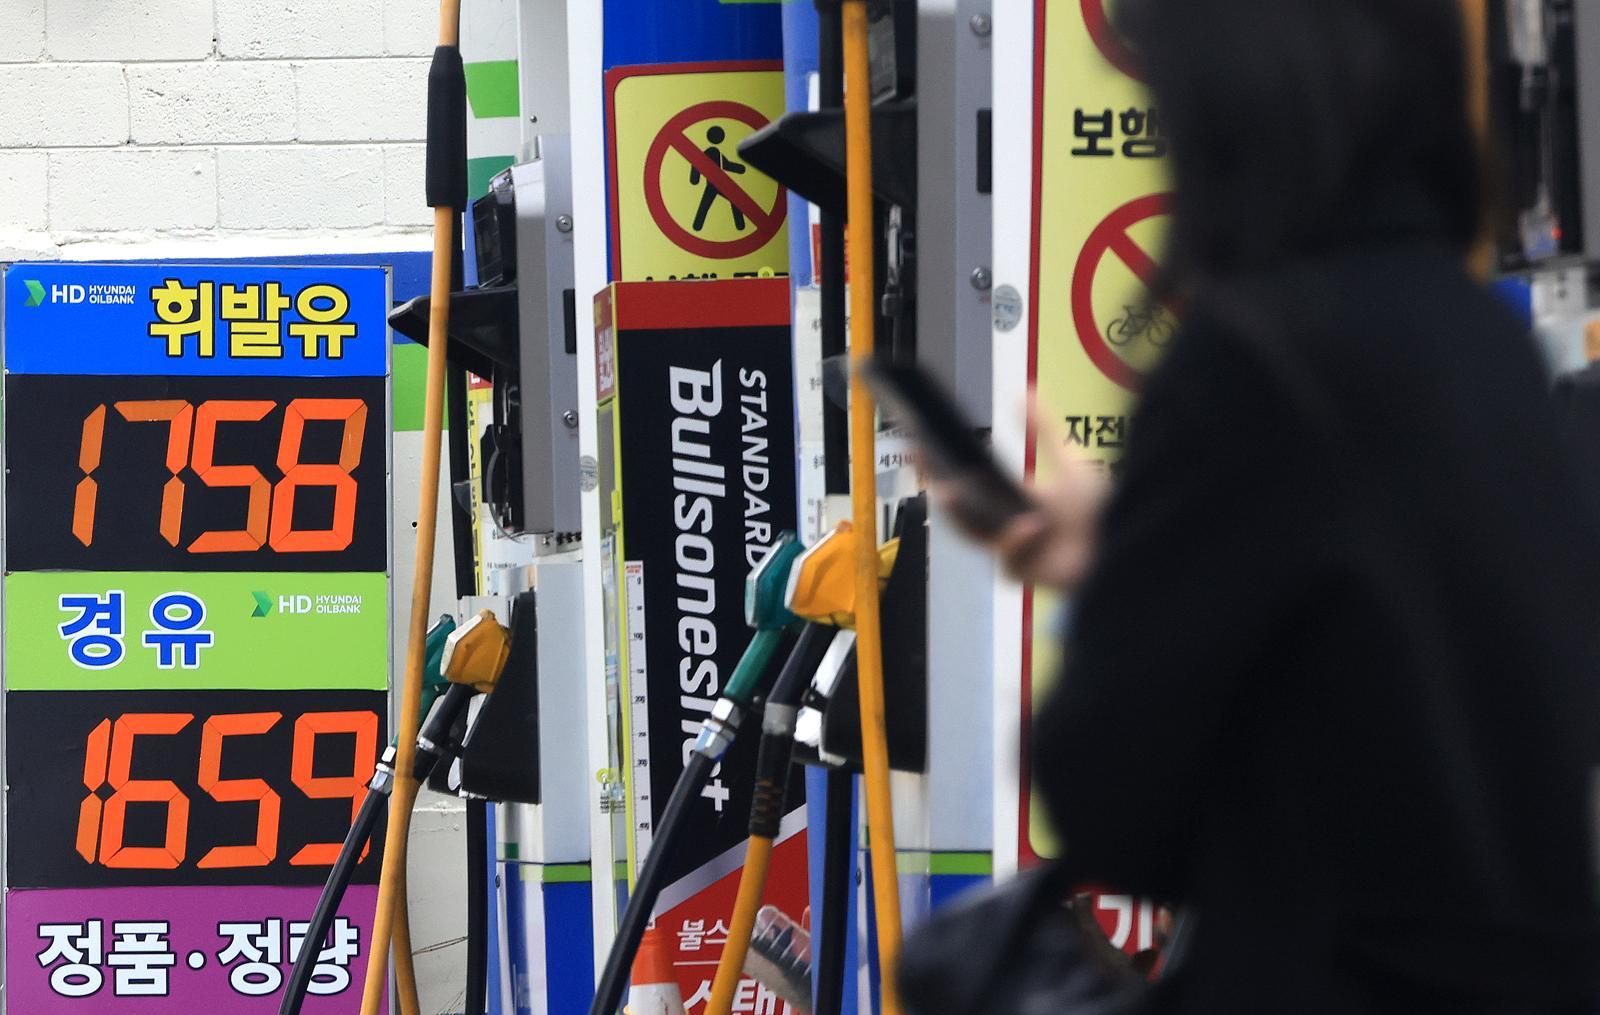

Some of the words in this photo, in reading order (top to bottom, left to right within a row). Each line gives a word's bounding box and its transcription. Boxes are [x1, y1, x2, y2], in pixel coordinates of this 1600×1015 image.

[51, 284, 86, 304] HD
[89, 285, 136, 295] HYUNDAI
[89, 294, 135, 304] OILBANK
[148, 279, 357, 358] 휘발유
[72, 398, 368, 553] 1758
[738, 367, 773, 570] STANDARD
[278, 595, 313, 614] HD
[316, 595, 362, 605] HYUNDAI
[316, 604, 361, 614] OILBANK
[76, 710, 379, 869] 1659
